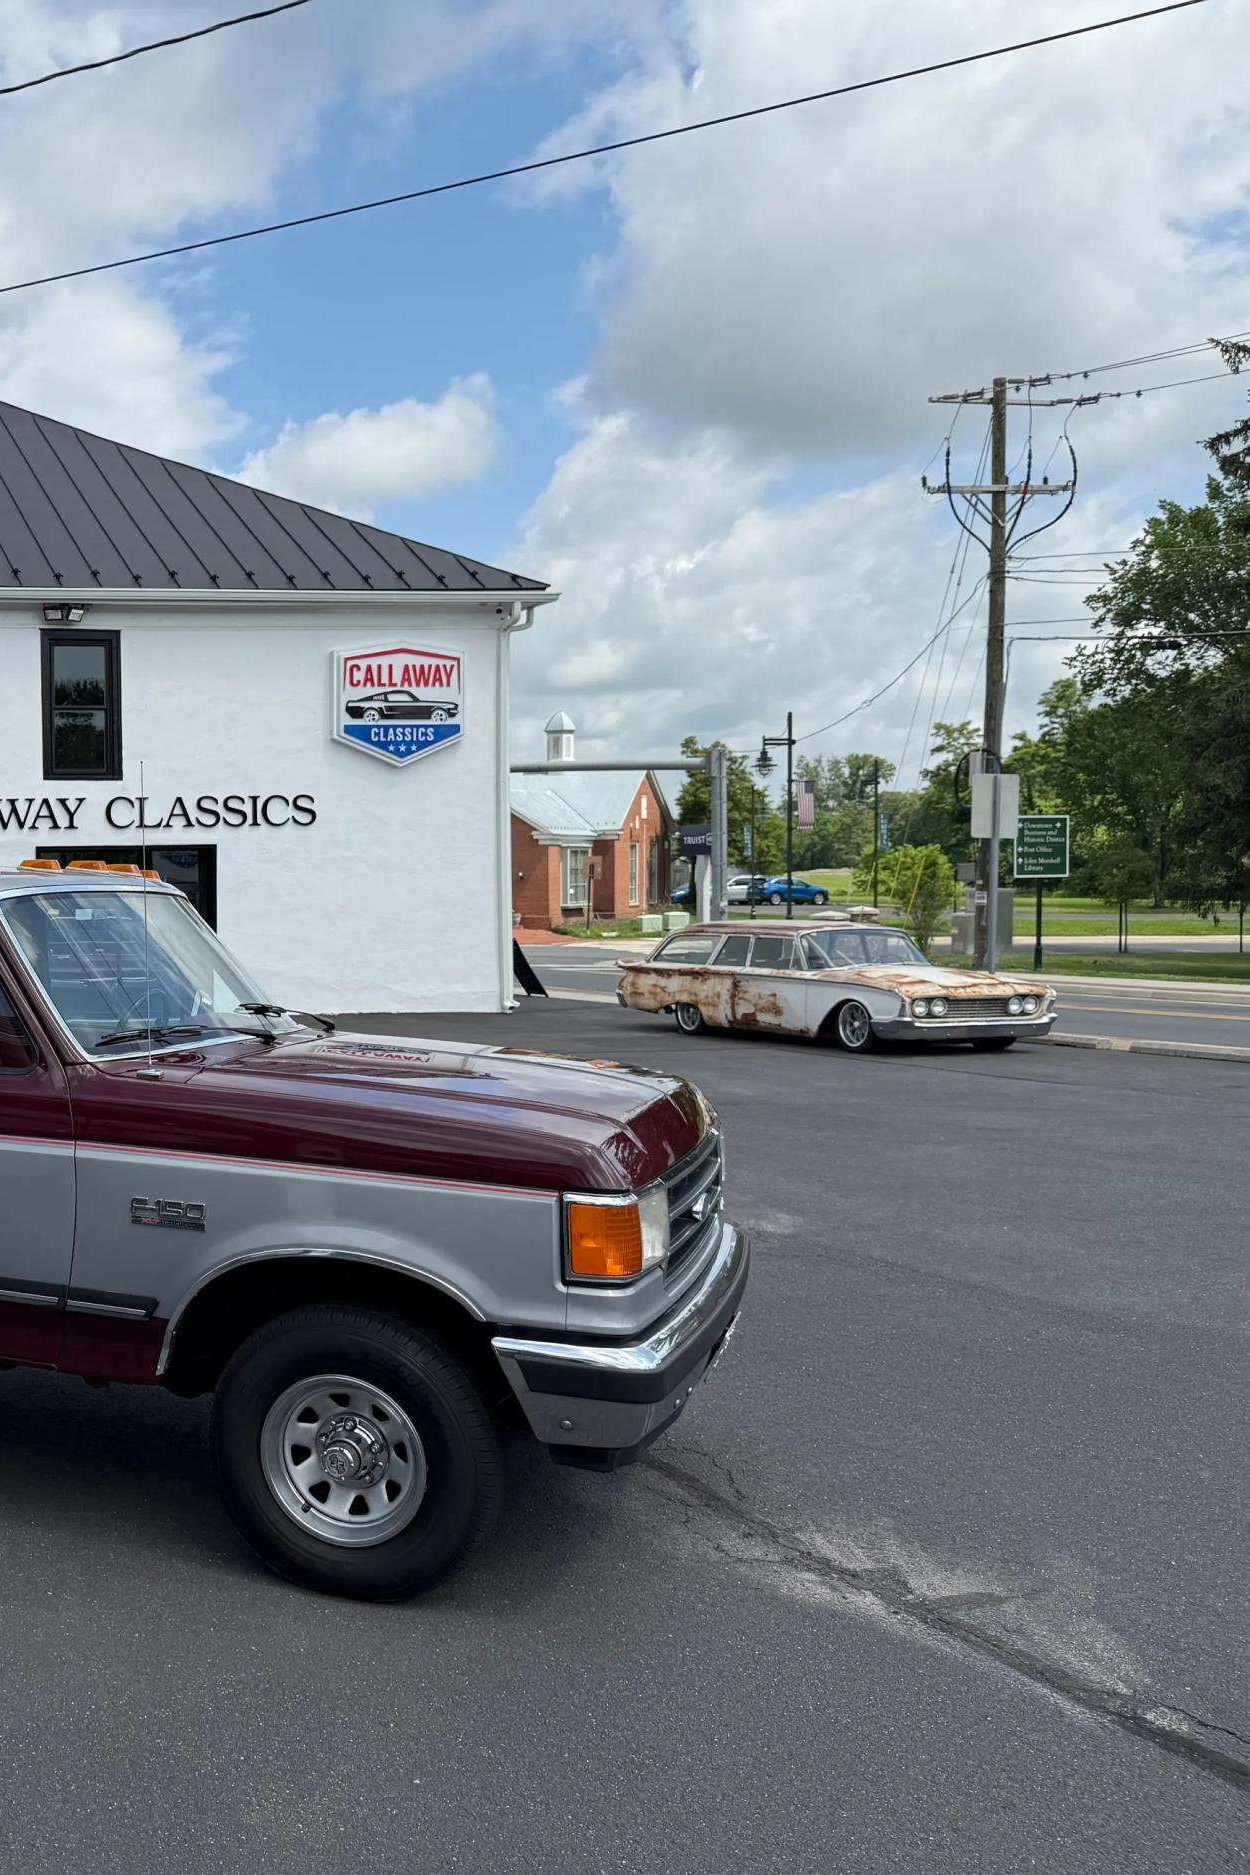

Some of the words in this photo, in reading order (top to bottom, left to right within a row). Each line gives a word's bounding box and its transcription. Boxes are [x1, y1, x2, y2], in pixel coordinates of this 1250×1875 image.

[349, 663, 455, 688] CALLAWAY
[371, 727, 435, 741] CLASSICS
[105, 794, 317, 829] CLASSICS
[683, 835, 706, 845] TRUIST
[1024, 864, 1044, 872] Library
[131, 1197, 206, 1220] F-150
